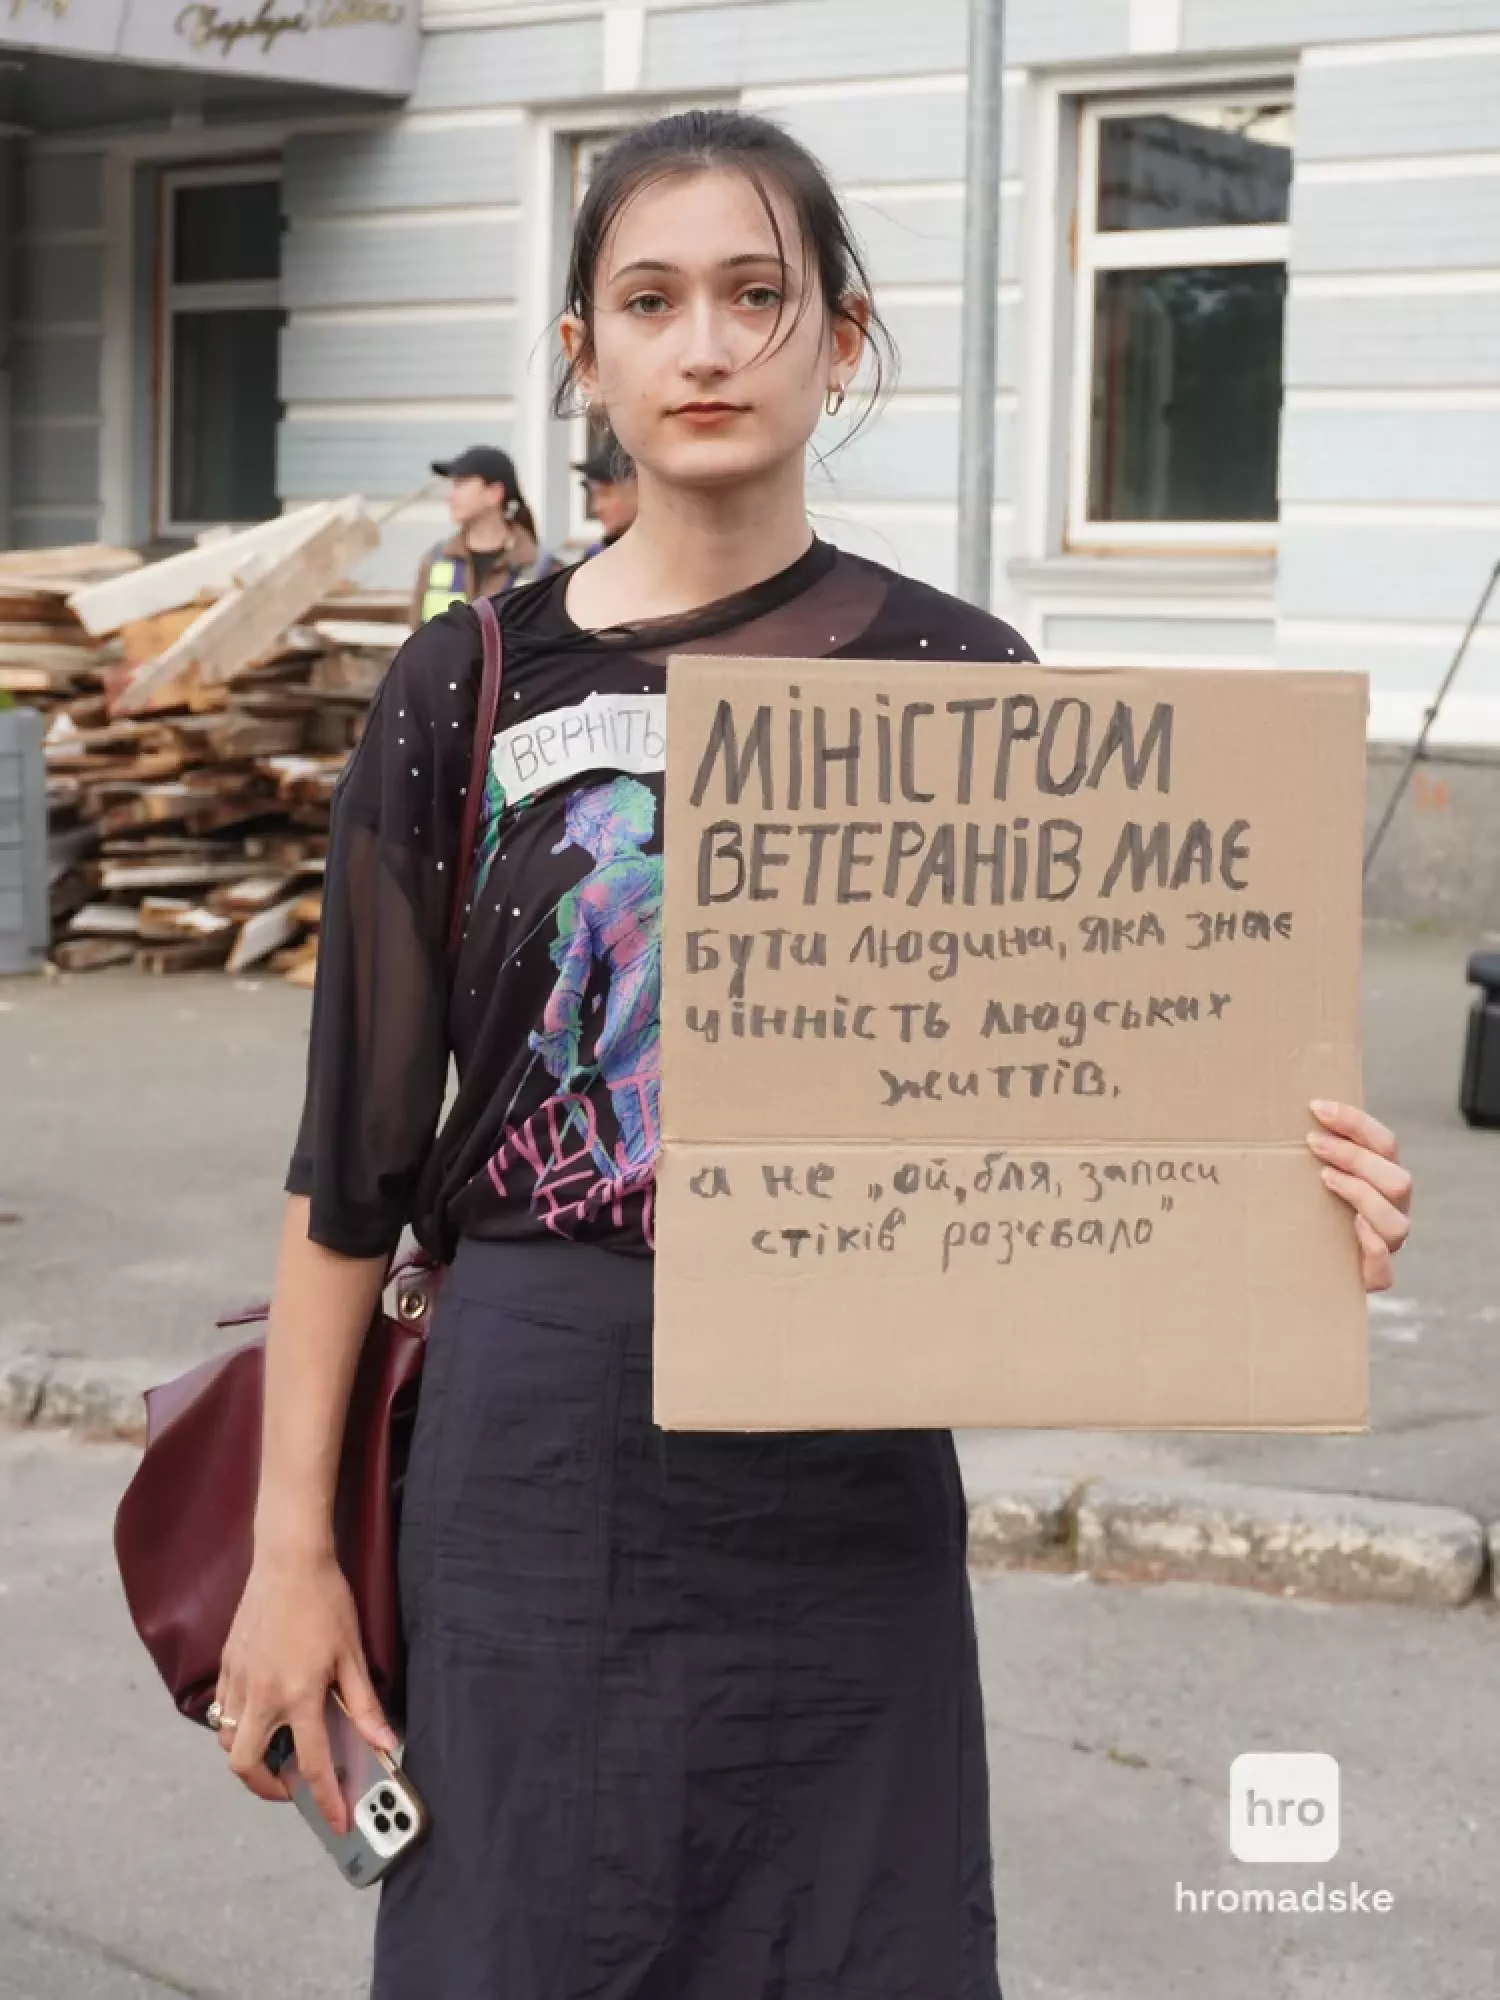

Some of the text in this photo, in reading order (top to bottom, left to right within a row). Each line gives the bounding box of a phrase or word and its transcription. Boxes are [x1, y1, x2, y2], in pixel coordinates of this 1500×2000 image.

[1097, 817, 1251, 899] МАЄ
[689, 1164, 732, 1199] а
[761, 1161, 836, 1200] не
